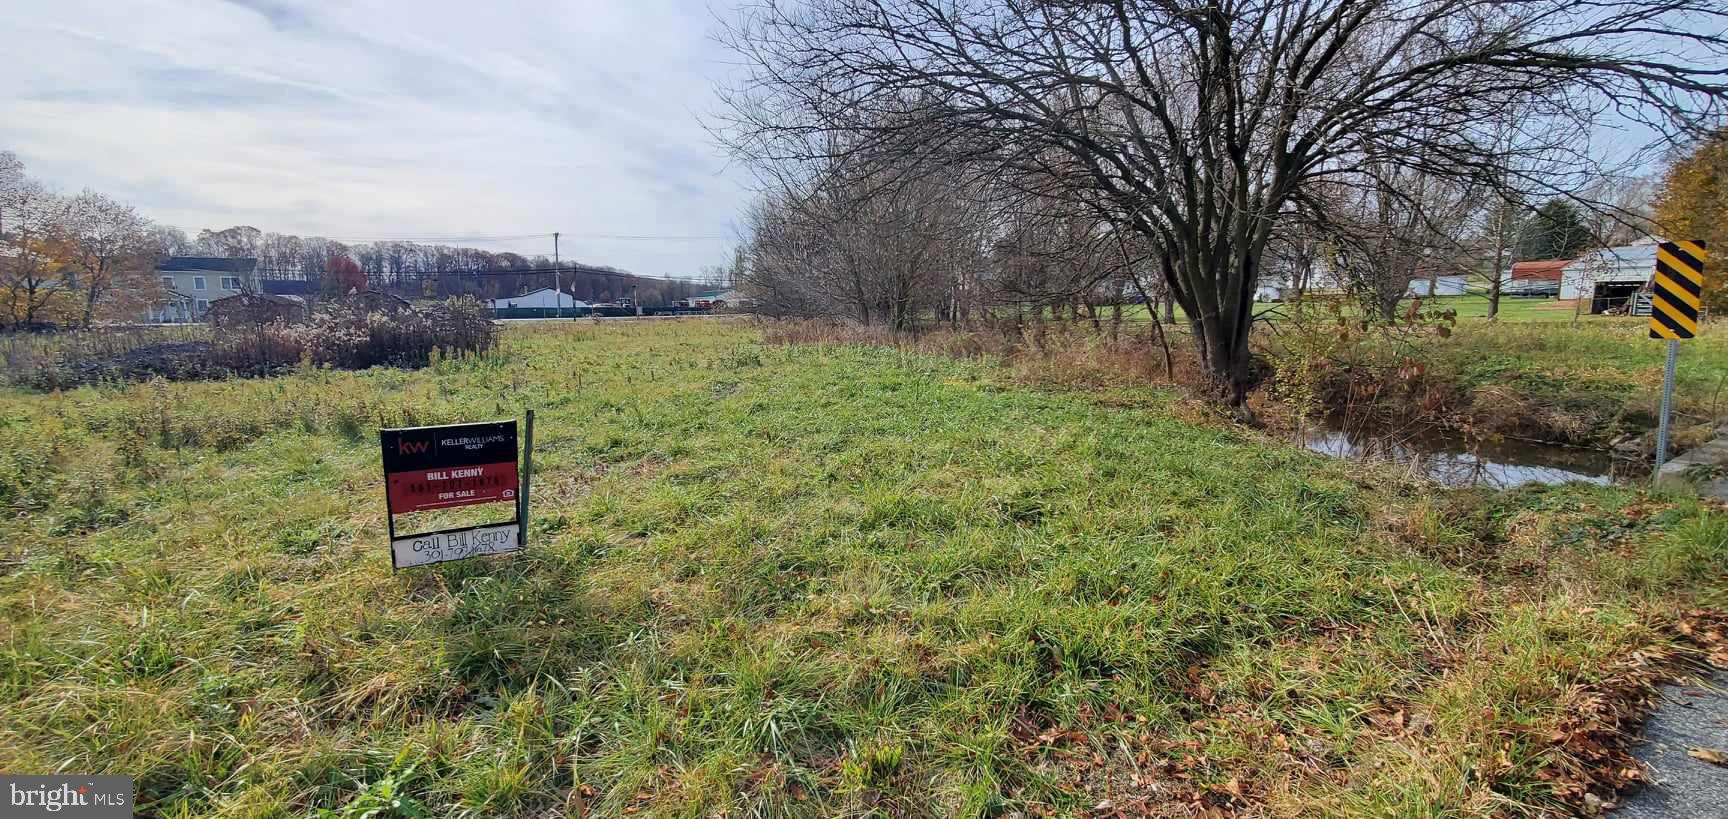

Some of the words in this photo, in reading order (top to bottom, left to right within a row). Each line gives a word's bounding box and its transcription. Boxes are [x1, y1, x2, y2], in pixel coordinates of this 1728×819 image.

[399, 438, 430, 456] kw
[426, 470, 450, 481] BILL
[451, 467, 484, 479] KENNY
[438, 491, 454, 500] FOR
[456, 489, 476, 498] SALE
[412, 536, 440, 552] Call
[447, 532, 468, 548] Bill
[472, 529, 511, 544] Kenny
